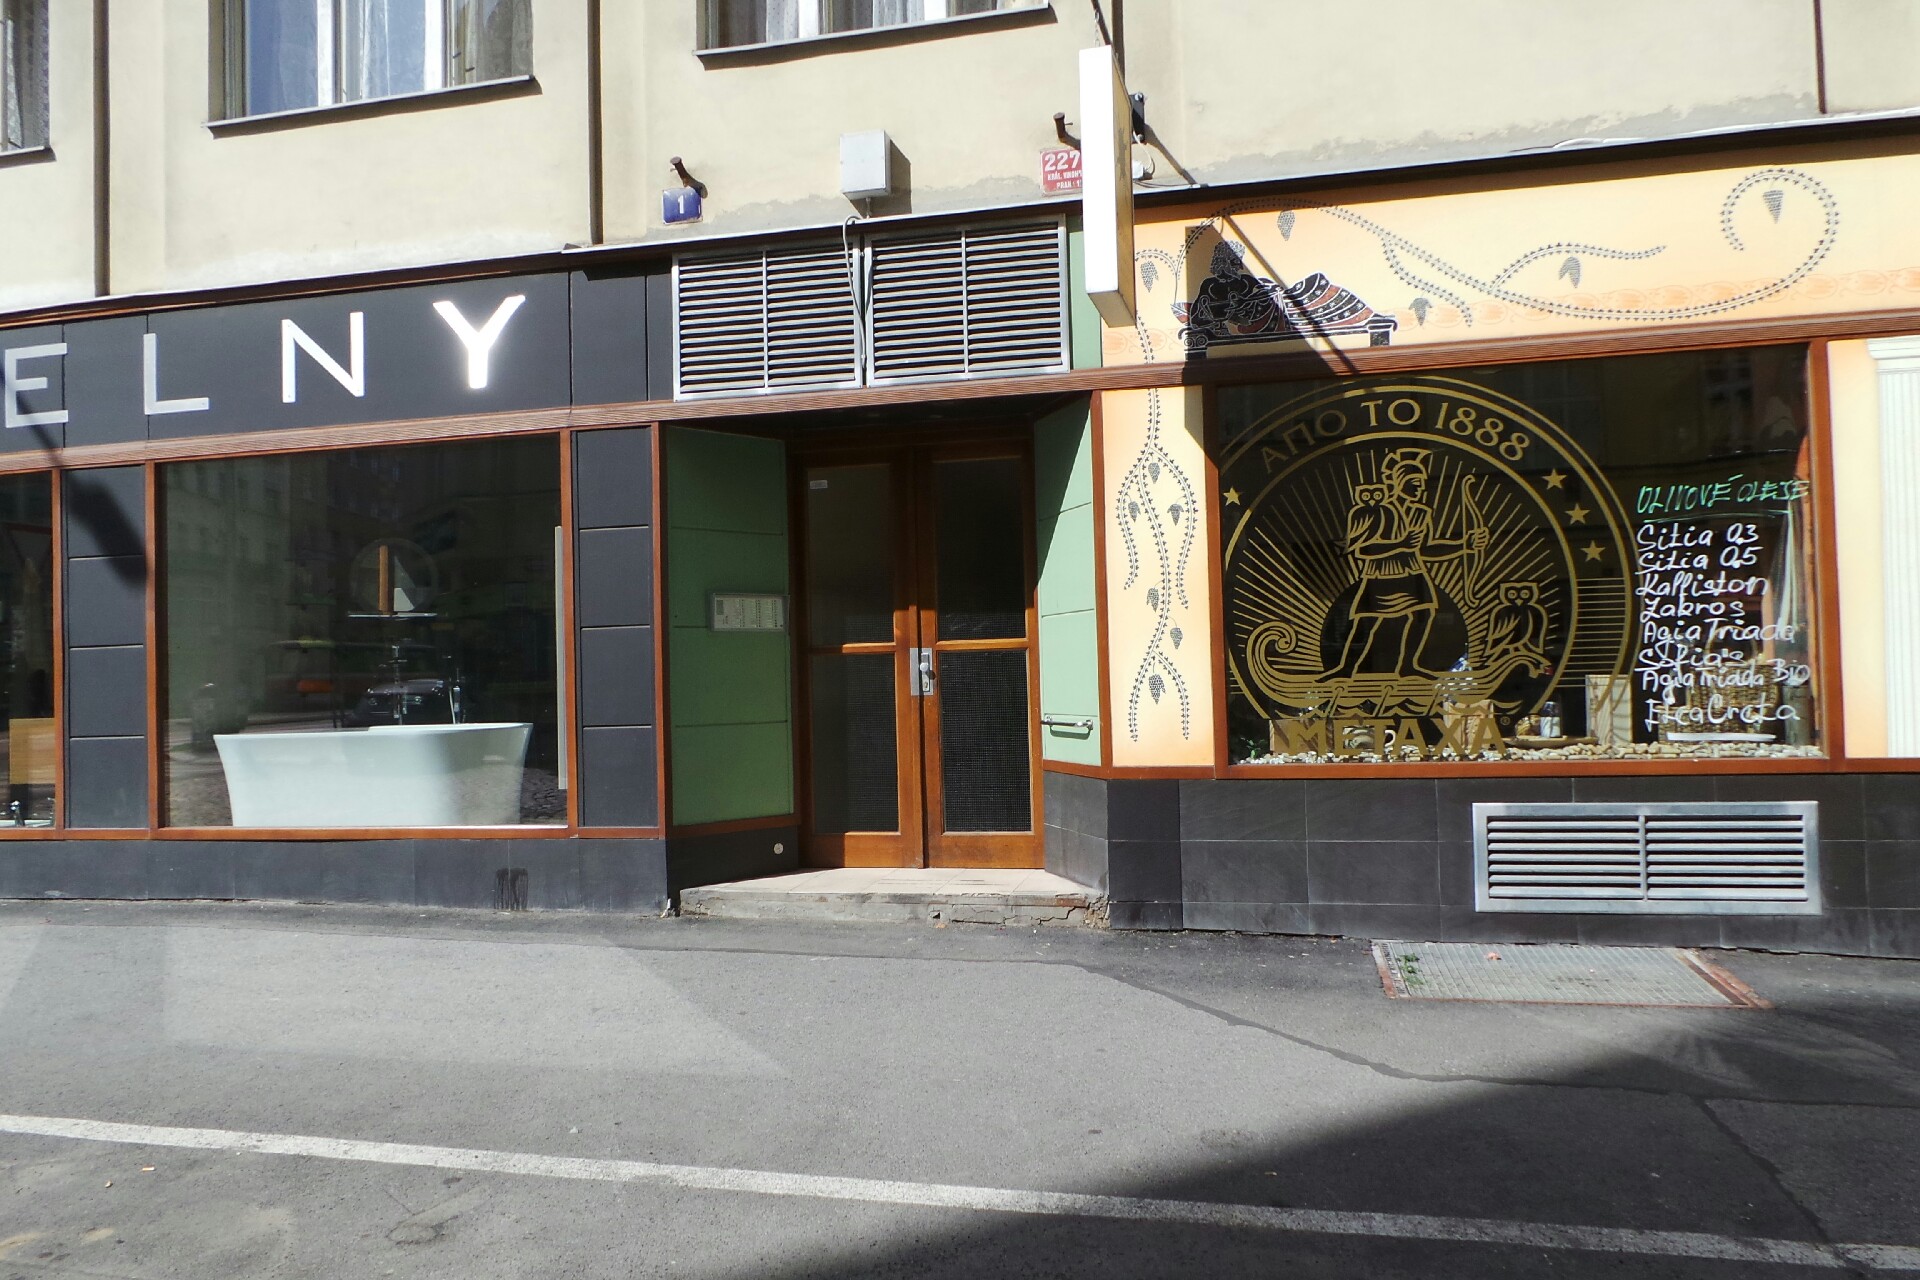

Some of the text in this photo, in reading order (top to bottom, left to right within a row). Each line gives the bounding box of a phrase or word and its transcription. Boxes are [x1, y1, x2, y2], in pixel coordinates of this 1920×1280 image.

[677, 194, 685, 214] 1
[1435, 402, 1530, 461] 1888
[1736, 480, 1810, 502] OLEJE
[1636, 523, 1713, 552] Sitia
[1635, 551, 1708, 574] Sitia
[1276, 717, 1507, 756] METAXA
